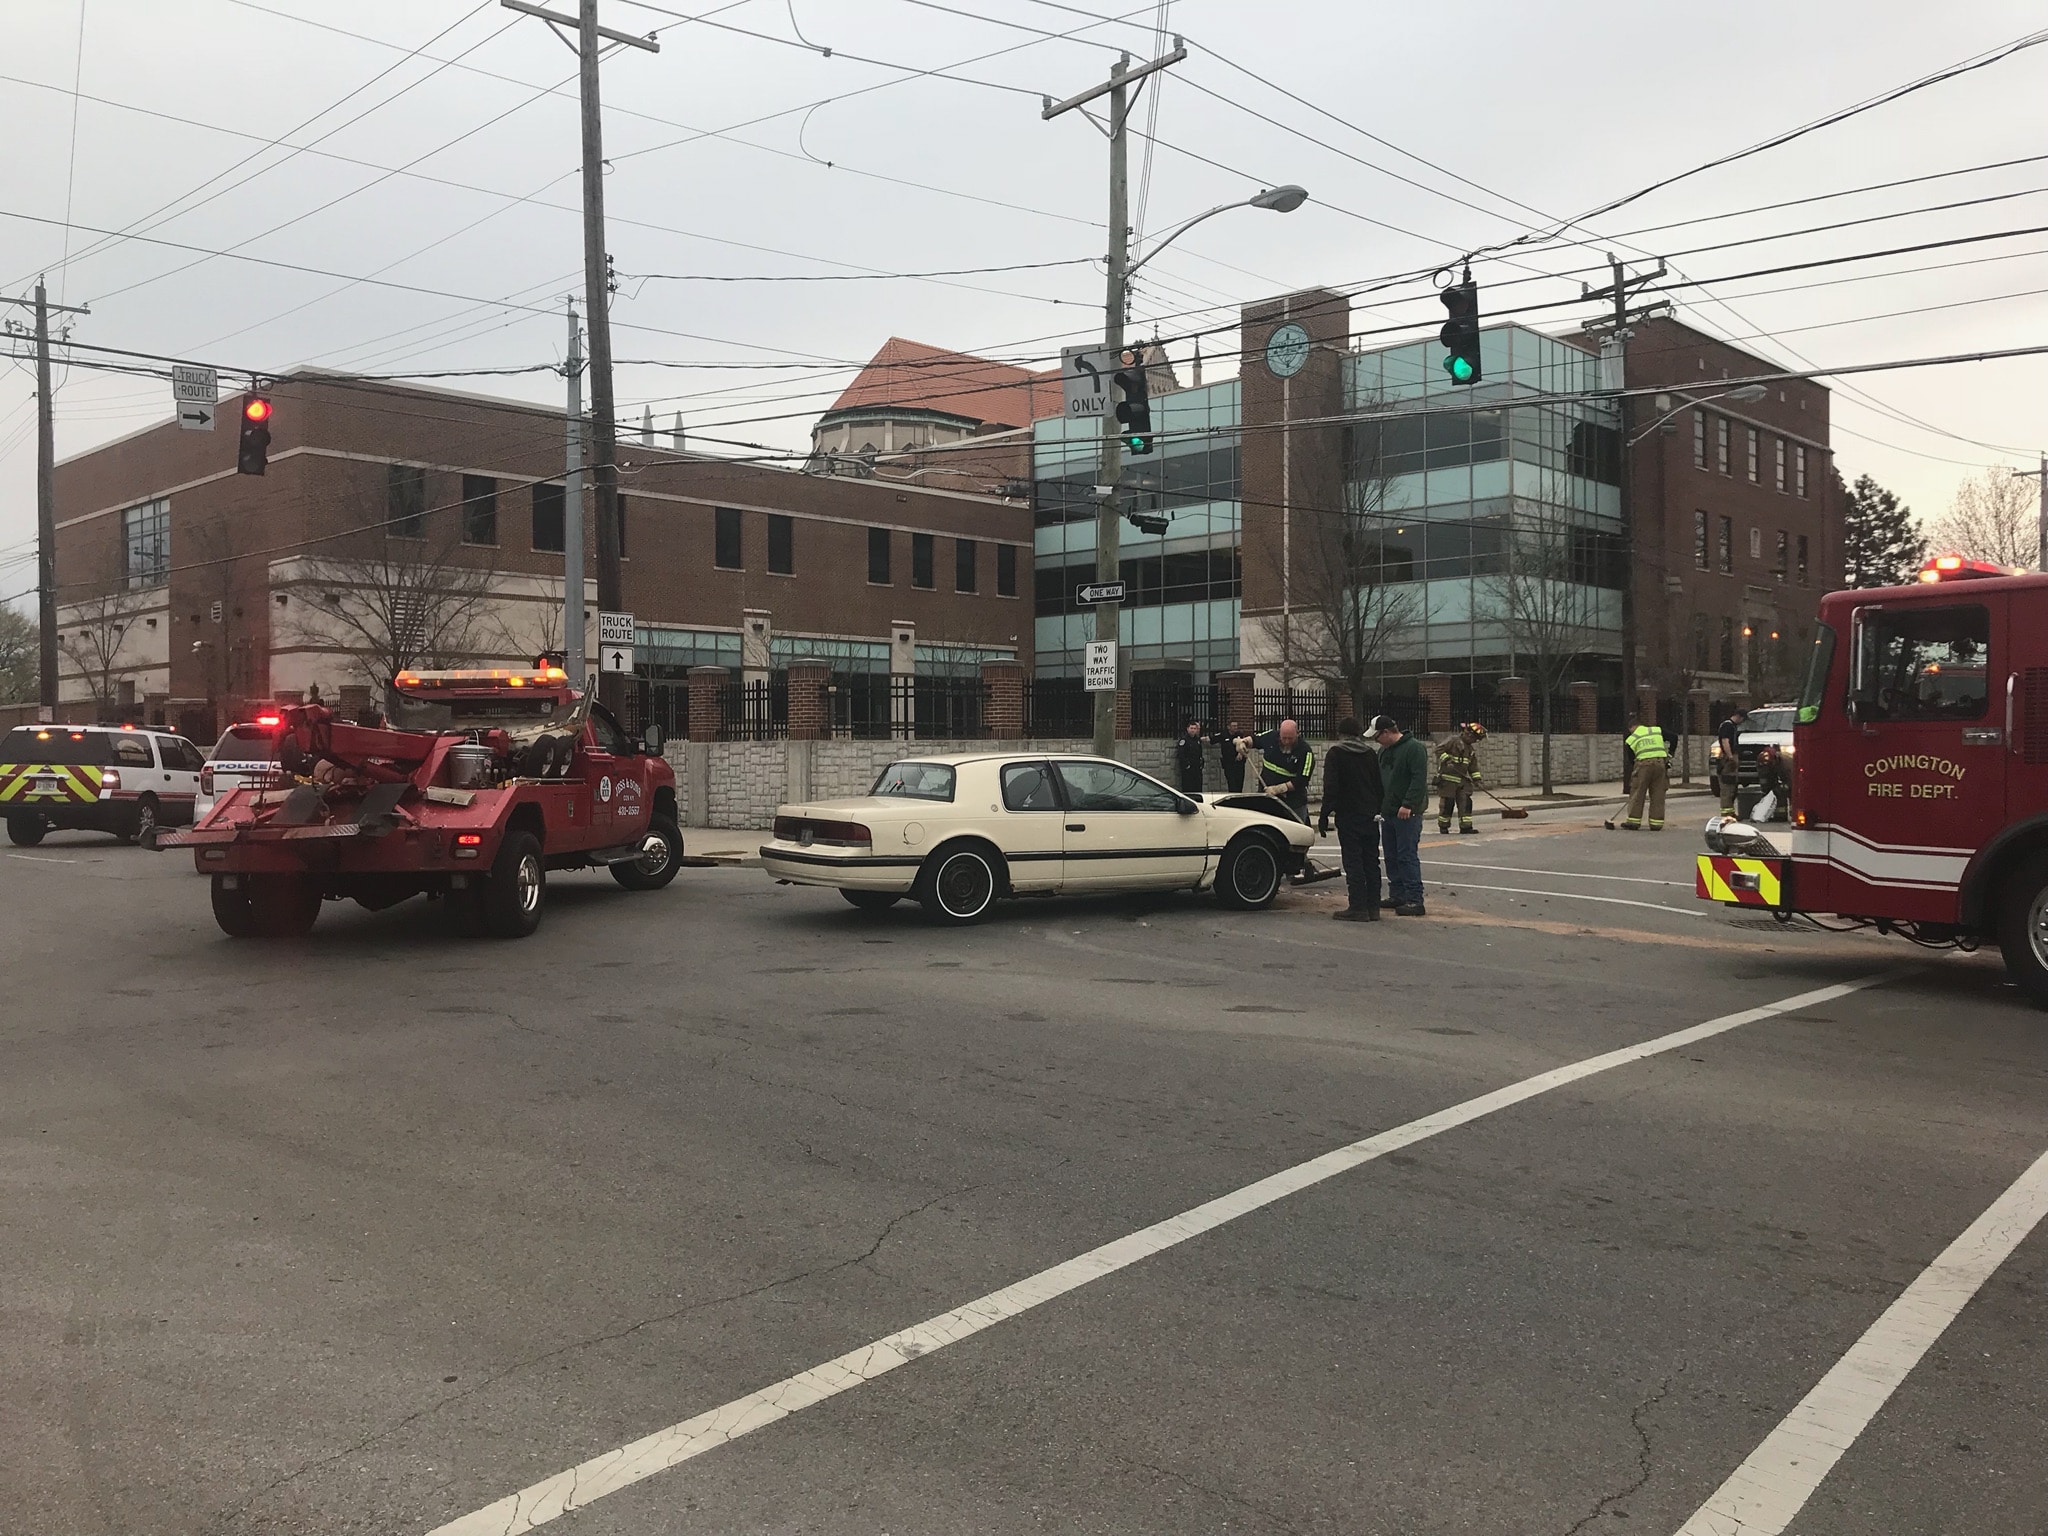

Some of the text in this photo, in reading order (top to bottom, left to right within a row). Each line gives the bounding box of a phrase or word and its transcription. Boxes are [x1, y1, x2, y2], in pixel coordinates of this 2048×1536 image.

[181, 371, 211, 384] TRUCK
[181, 385, 212, 397] ROUTE
[1072, 397, 1106, 412] ONLY
[1090, 587, 1120, 597] ONE WAY
[601, 616, 632, 627] TRUCK
[602, 629, 632, 639] ROUTE
[1094, 645, 1108, 654] TWO
[1093, 656, 1108, 664] WAY
[1087, 666, 1115, 675] TRAFFIC
[1088, 677, 1113, 686] BEGINS
[1864, 754, 1966, 780] COVINGTON
[602, 779, 609, 788] 24
[1868, 783, 1959, 799] FIRE DEPT.
